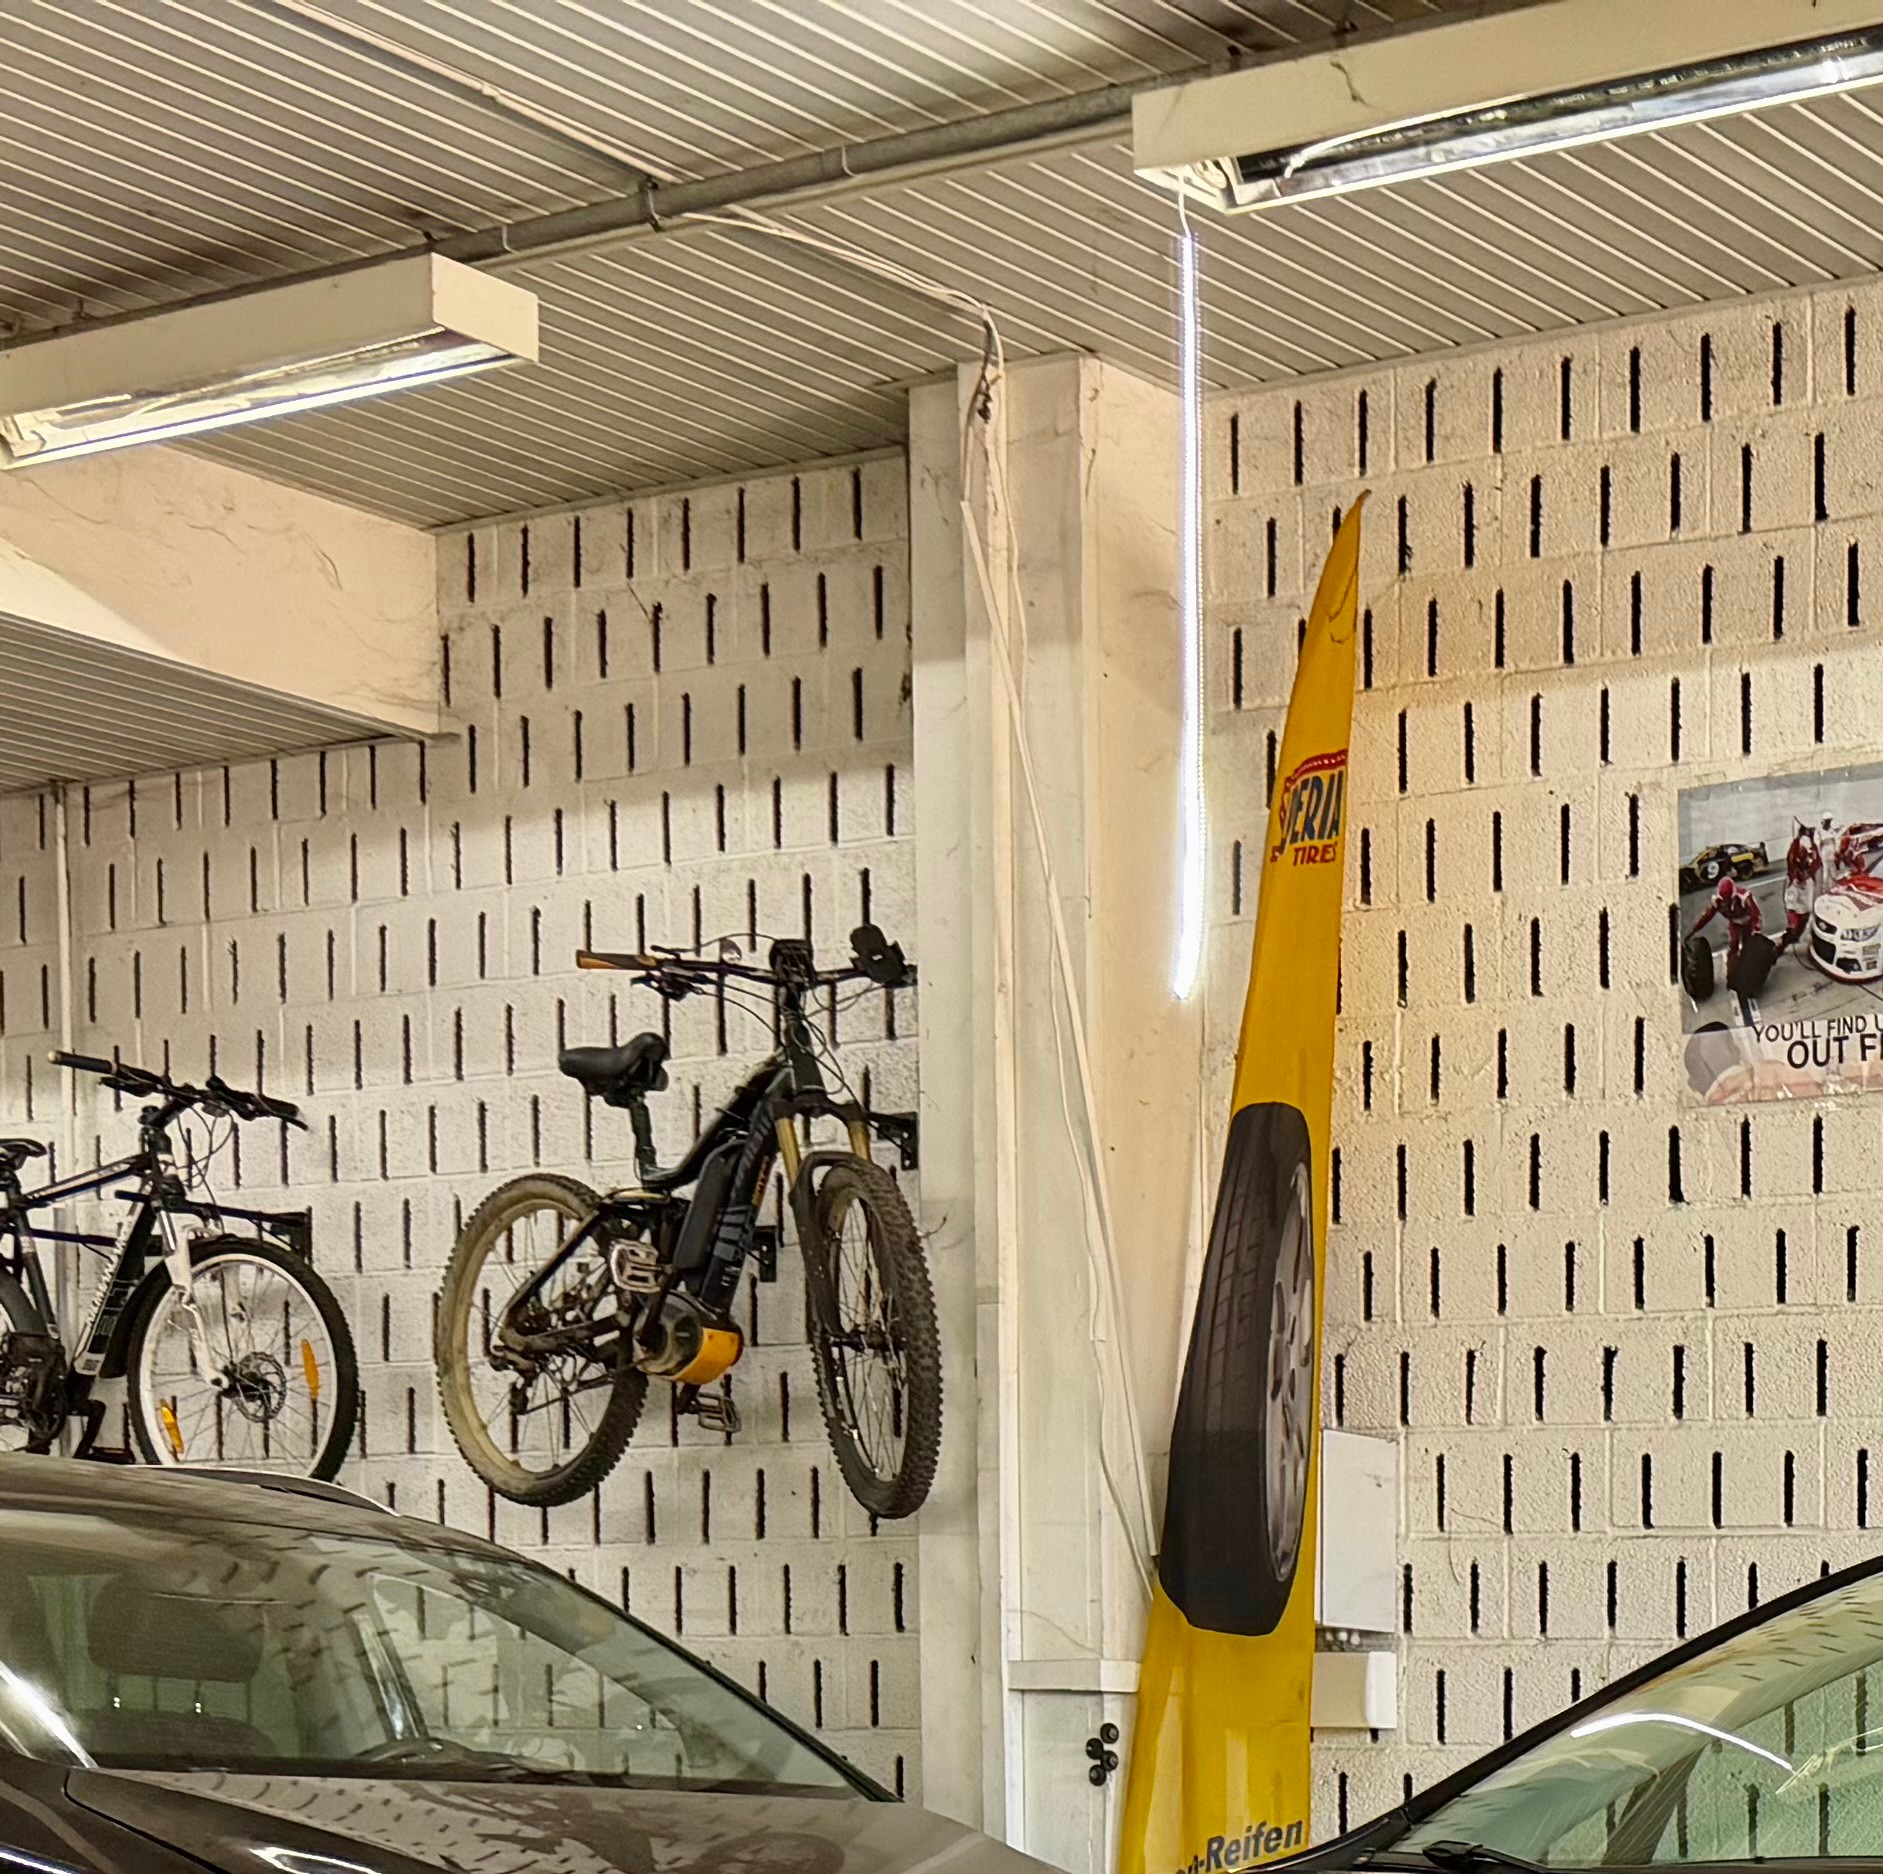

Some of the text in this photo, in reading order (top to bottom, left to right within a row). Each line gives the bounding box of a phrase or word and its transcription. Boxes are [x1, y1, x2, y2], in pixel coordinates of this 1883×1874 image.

[1753, 1021, 1822, 1043] YOU'LL
[1827, 1015, 1867, 1037] FIND
[1787, 1035, 1849, 1069] OUT
